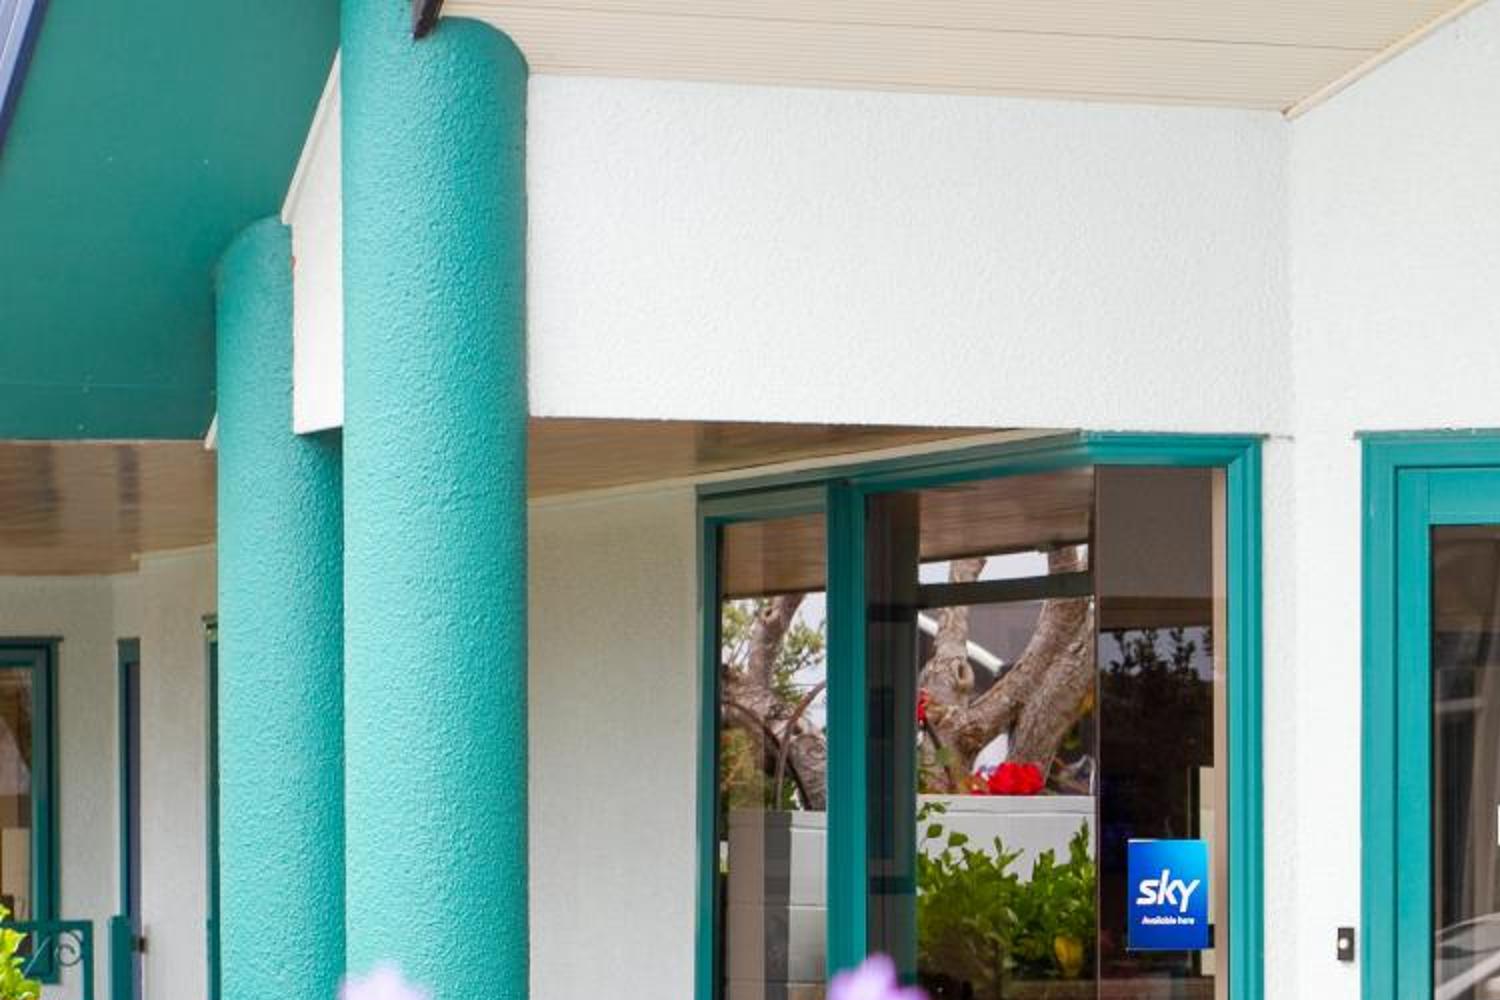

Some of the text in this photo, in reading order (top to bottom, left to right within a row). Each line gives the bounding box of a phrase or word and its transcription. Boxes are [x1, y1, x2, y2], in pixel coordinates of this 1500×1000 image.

[1135, 868, 1201, 913] sky
[1141, 915, 1195, 926] Available here
